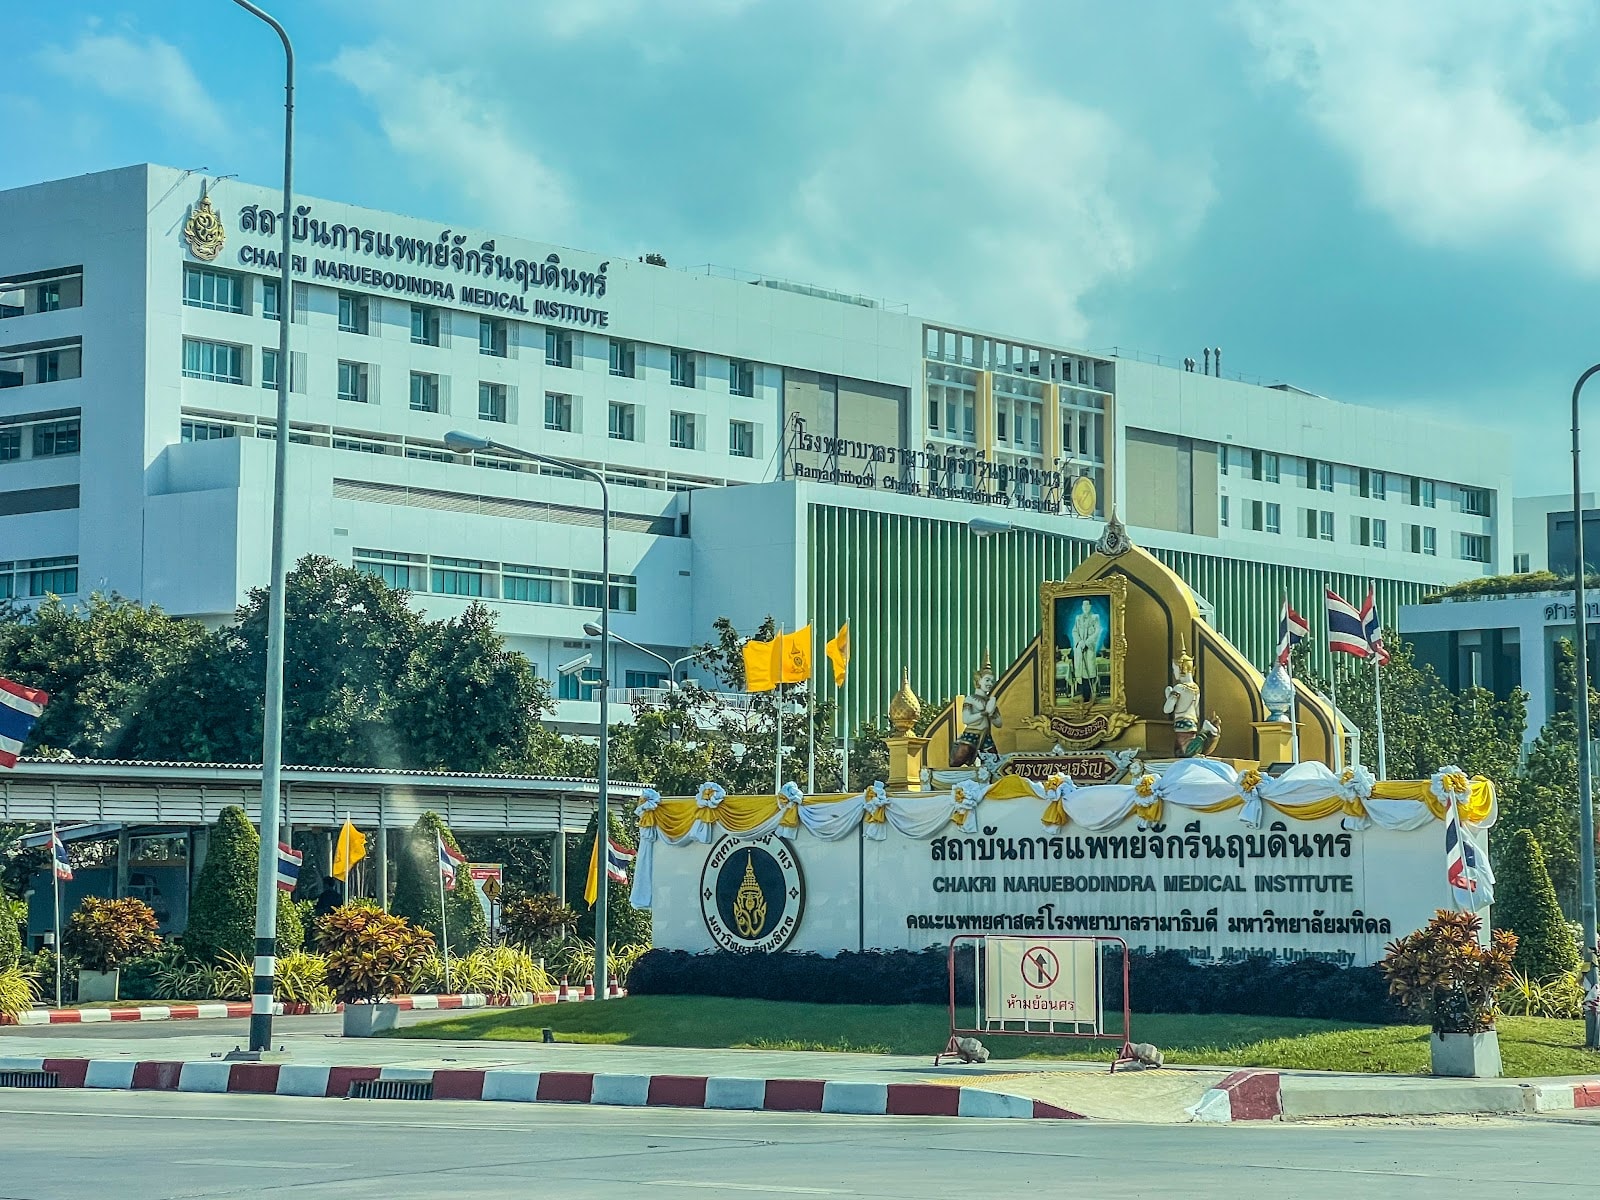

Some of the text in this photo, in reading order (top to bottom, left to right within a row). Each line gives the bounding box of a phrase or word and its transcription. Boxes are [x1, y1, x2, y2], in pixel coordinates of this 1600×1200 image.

[315, 259, 455, 300] NARUEBODINDRA
[462, 286, 529, 312] MEDICAL
[535, 299, 609, 327] INSTITUTE
[1014, 759, 1102, 779] ทรงพระเจริญ
[932, 875, 1353, 893] CHAKRI NARUEBODINDRA MEDICAL INSTITUTE
[906, 904, 1391, 934] คณะแพทยศาสตร์โรงพยาบาลรามาธิบดี มหาวิทยาลัยมหิดล
[1155, 945, 1214, 960] pital,
[1006, 993, 1075, 1011] ห้ามย้อนศร
